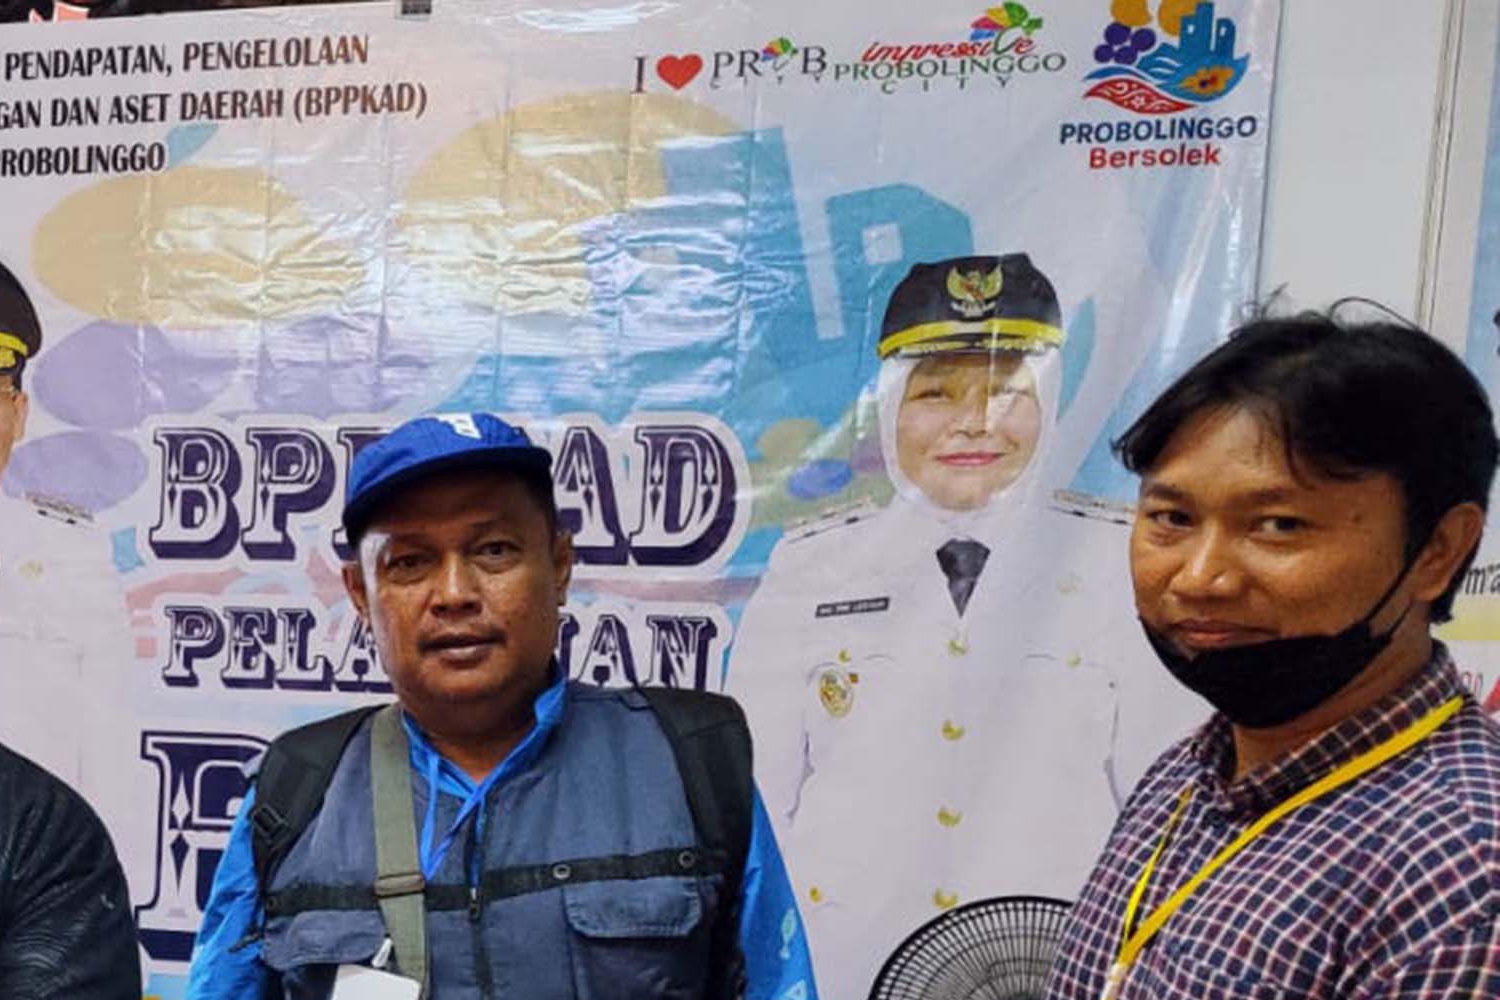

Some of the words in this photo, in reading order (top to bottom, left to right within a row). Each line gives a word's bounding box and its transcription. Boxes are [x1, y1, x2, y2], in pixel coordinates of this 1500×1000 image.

[5, 44, 173, 80] PENDAPATAN,
[183, 34, 369, 71] PENGELOLAAN
[834, 52, 1067, 81] PROBOLINGGO
[631, 56, 647, 93] I
[881, 76, 1012, 95] CITY
[50, 96, 100, 127] DAN
[108, 93, 171, 124] ASET
[180, 88, 284, 120] DAERAH
[293, 83, 428, 122] (BPPKAD)
[1060, 115, 1258, 144] PROBOLINGGO
[1088, 143, 1222, 169] Bersolek
[150, 425, 738, 566] BPAD
